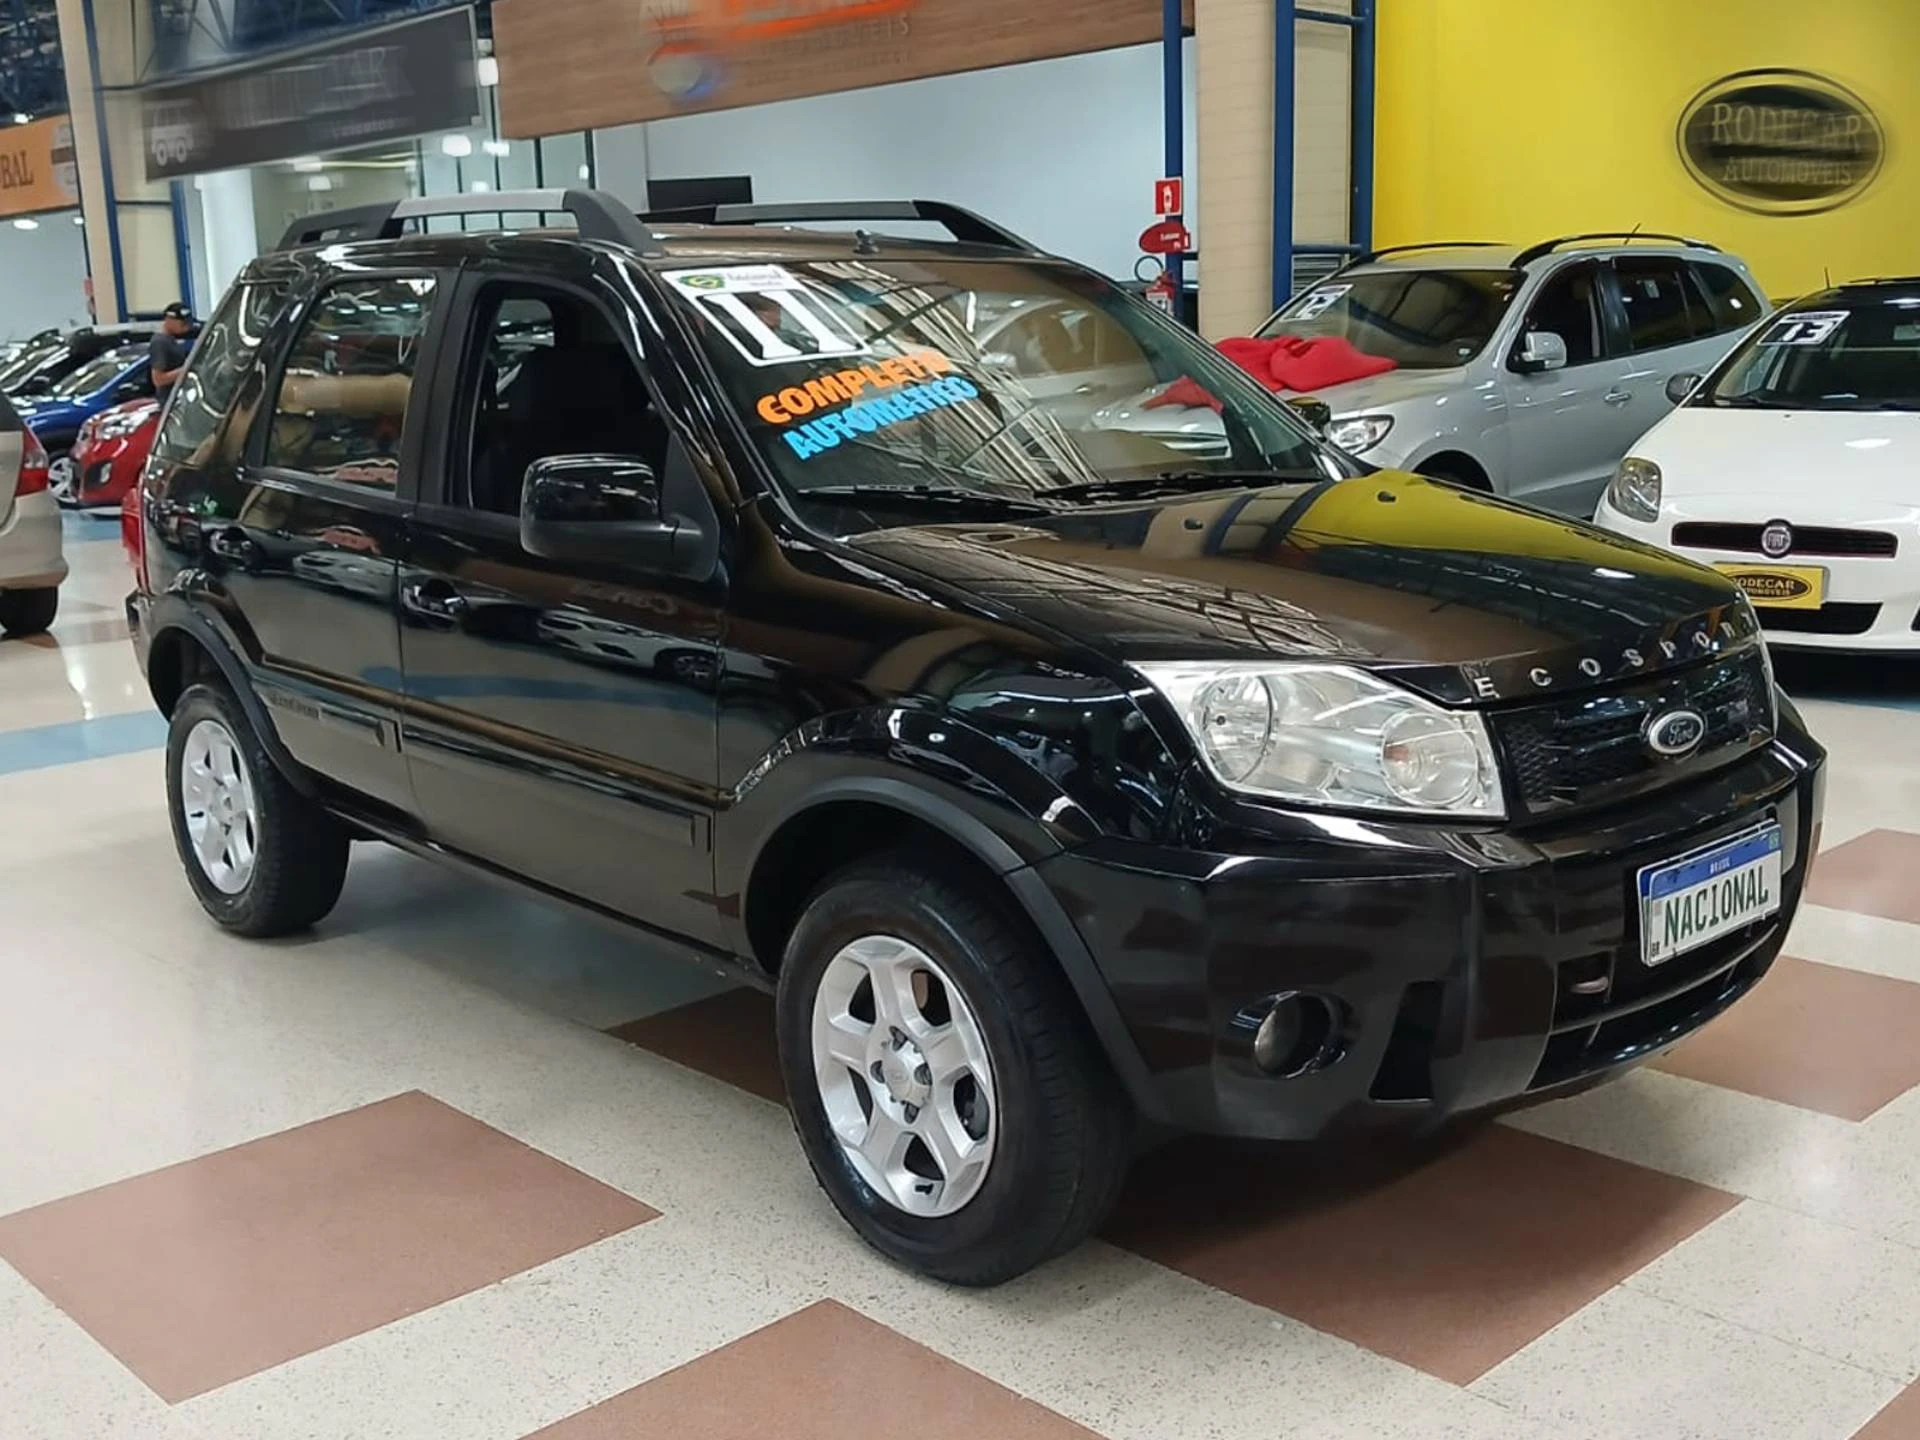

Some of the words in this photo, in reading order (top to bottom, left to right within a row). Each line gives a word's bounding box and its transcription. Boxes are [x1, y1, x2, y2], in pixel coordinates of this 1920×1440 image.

[1711, 102, 1862, 153] RODECAR
[756, 350, 953, 424] COMPLETO
[782, 375, 979, 460] AUTOMATICO
[1767, 532, 1786, 547] FIAT
[1664, 865, 1769, 947] NACIONAL
